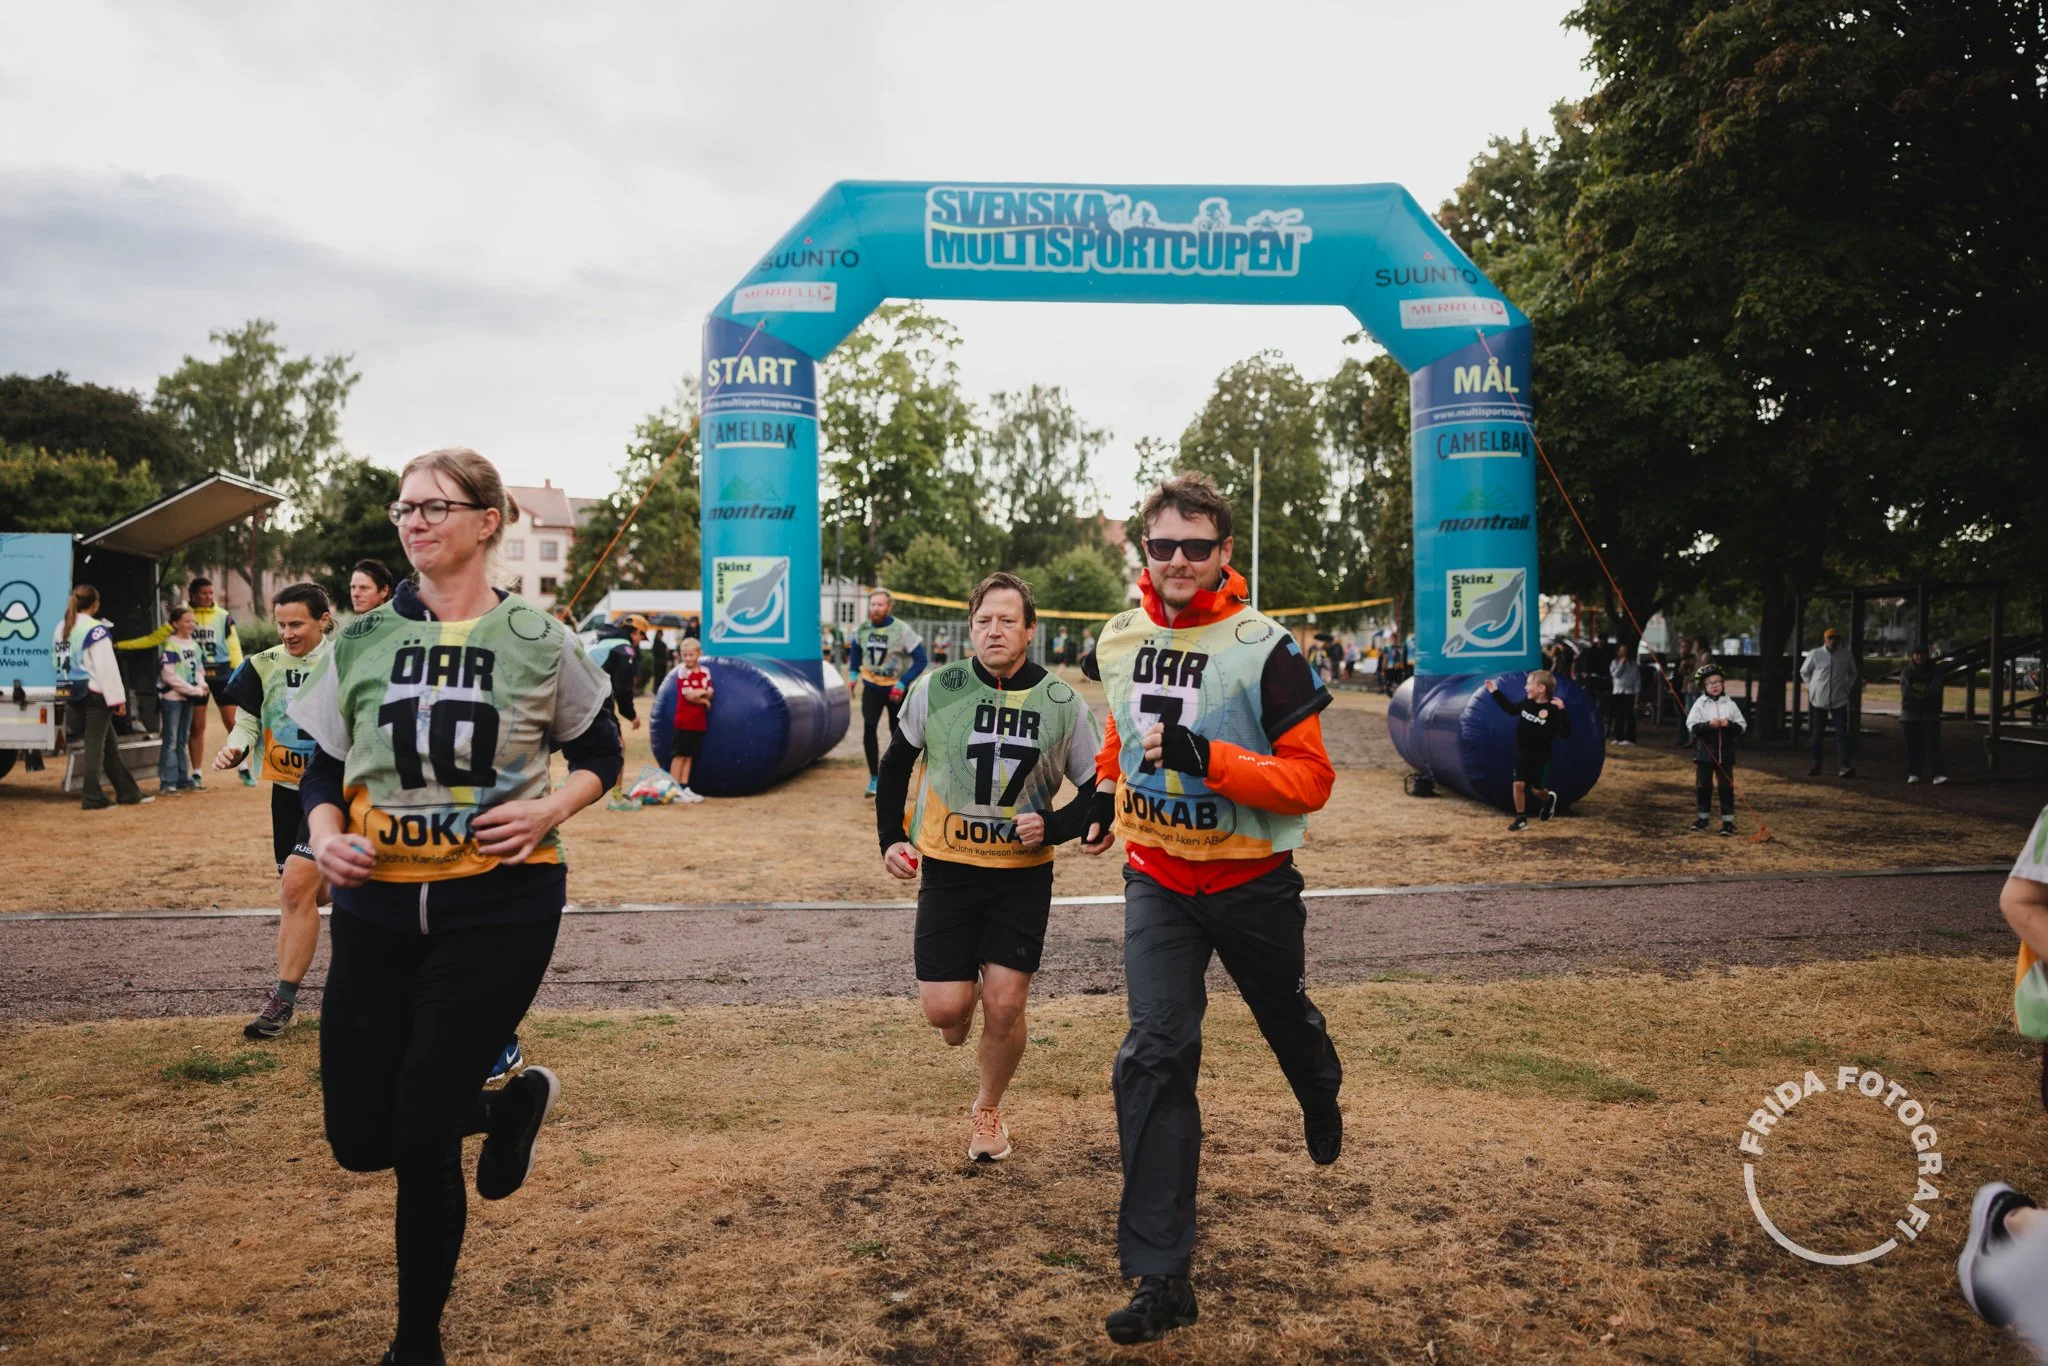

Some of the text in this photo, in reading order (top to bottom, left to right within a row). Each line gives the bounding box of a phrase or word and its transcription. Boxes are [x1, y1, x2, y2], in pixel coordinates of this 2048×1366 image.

[931, 189, 1101, 229] SVENSKA
[760, 249, 860, 272] SUUNTO
[931, 227, 1295, 272] MULTISPORTCUPEN
[1375, 266, 1478, 287] SUUNTO
[1410, 301, 1488, 315] MERRELL
[707, 355, 797, 387] START
[1454, 356, 1519, 395] MÅL
[707, 421, 797, 450] CAMELBAK
[1437, 430, 1529, 460] CAMELBAK
[708, 503, 797, 520] montrail
[1439, 514, 1530, 532] montrail
[717, 562, 752, 573] Skinz
[1451, 573, 1494, 585] Skinz
[1451, 585, 1462, 618] Seal
[0, 658, 29, 667] Week
[3, 646, 49, 656] Extreme
[390, 638, 495, 692] ÖAR
[1132, 639, 1209, 689] ÖAR
[974, 698, 1041, 740] ÖAR
[378, 696, 499, 790] 10
[1138, 693, 1184, 776] 7
[966, 742, 1041, 807] 17
[1122, 788, 1219, 831] JOKAB
[294, 843, 314, 856] FUS
[956, 844, 973, 855] John
[975, 848, 1011, 857] Karlsson
[1204, 836, 1219, 846] AB
[380, 854, 410, 865] John
